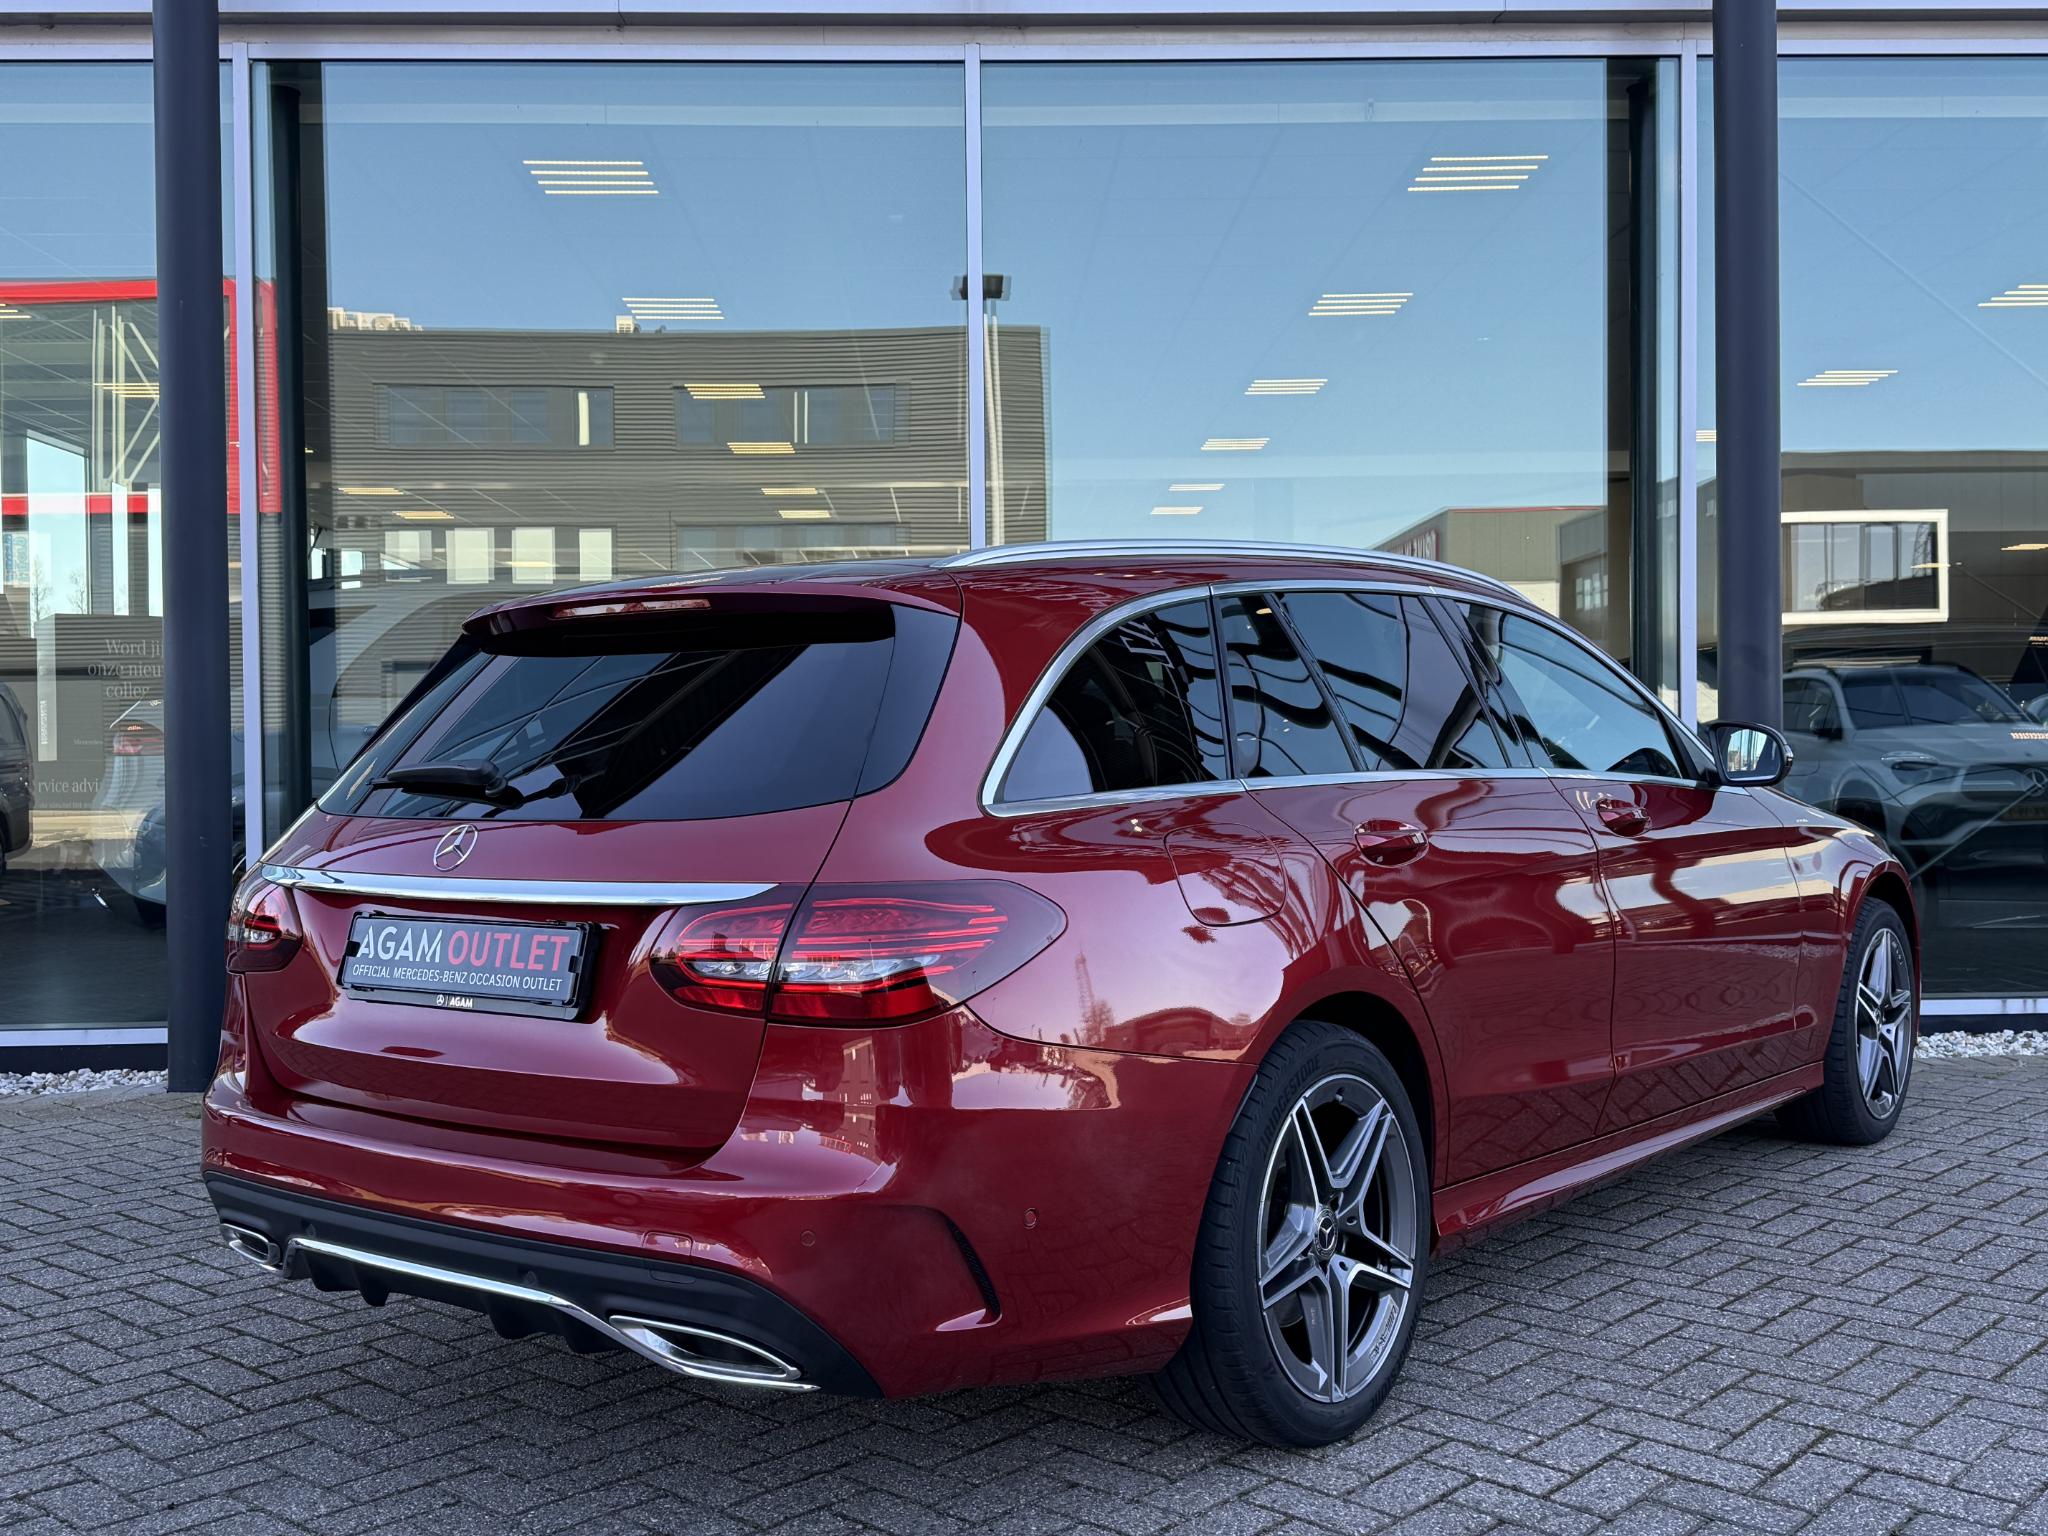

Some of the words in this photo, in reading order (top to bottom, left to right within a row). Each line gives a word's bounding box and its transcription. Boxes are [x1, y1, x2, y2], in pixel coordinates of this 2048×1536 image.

[105, 639, 146, 655] Word
[88, 663, 123, 676] onze
[128, 661, 163, 677] nieu
[38, 778, 69, 793] rvice
[72, 778, 98, 793] advi
[357, 925, 443, 964] AGAM
[448, 930, 570, 972] OUTLET
[352, 964, 391, 978] OFFICIAL
[393, 967, 468, 984] MERCEDES-BENZ
[469, 972, 520, 988] OCCASION
[522, 976, 563, 991] OUTLET
[449, 996, 473, 1008] AGAM
